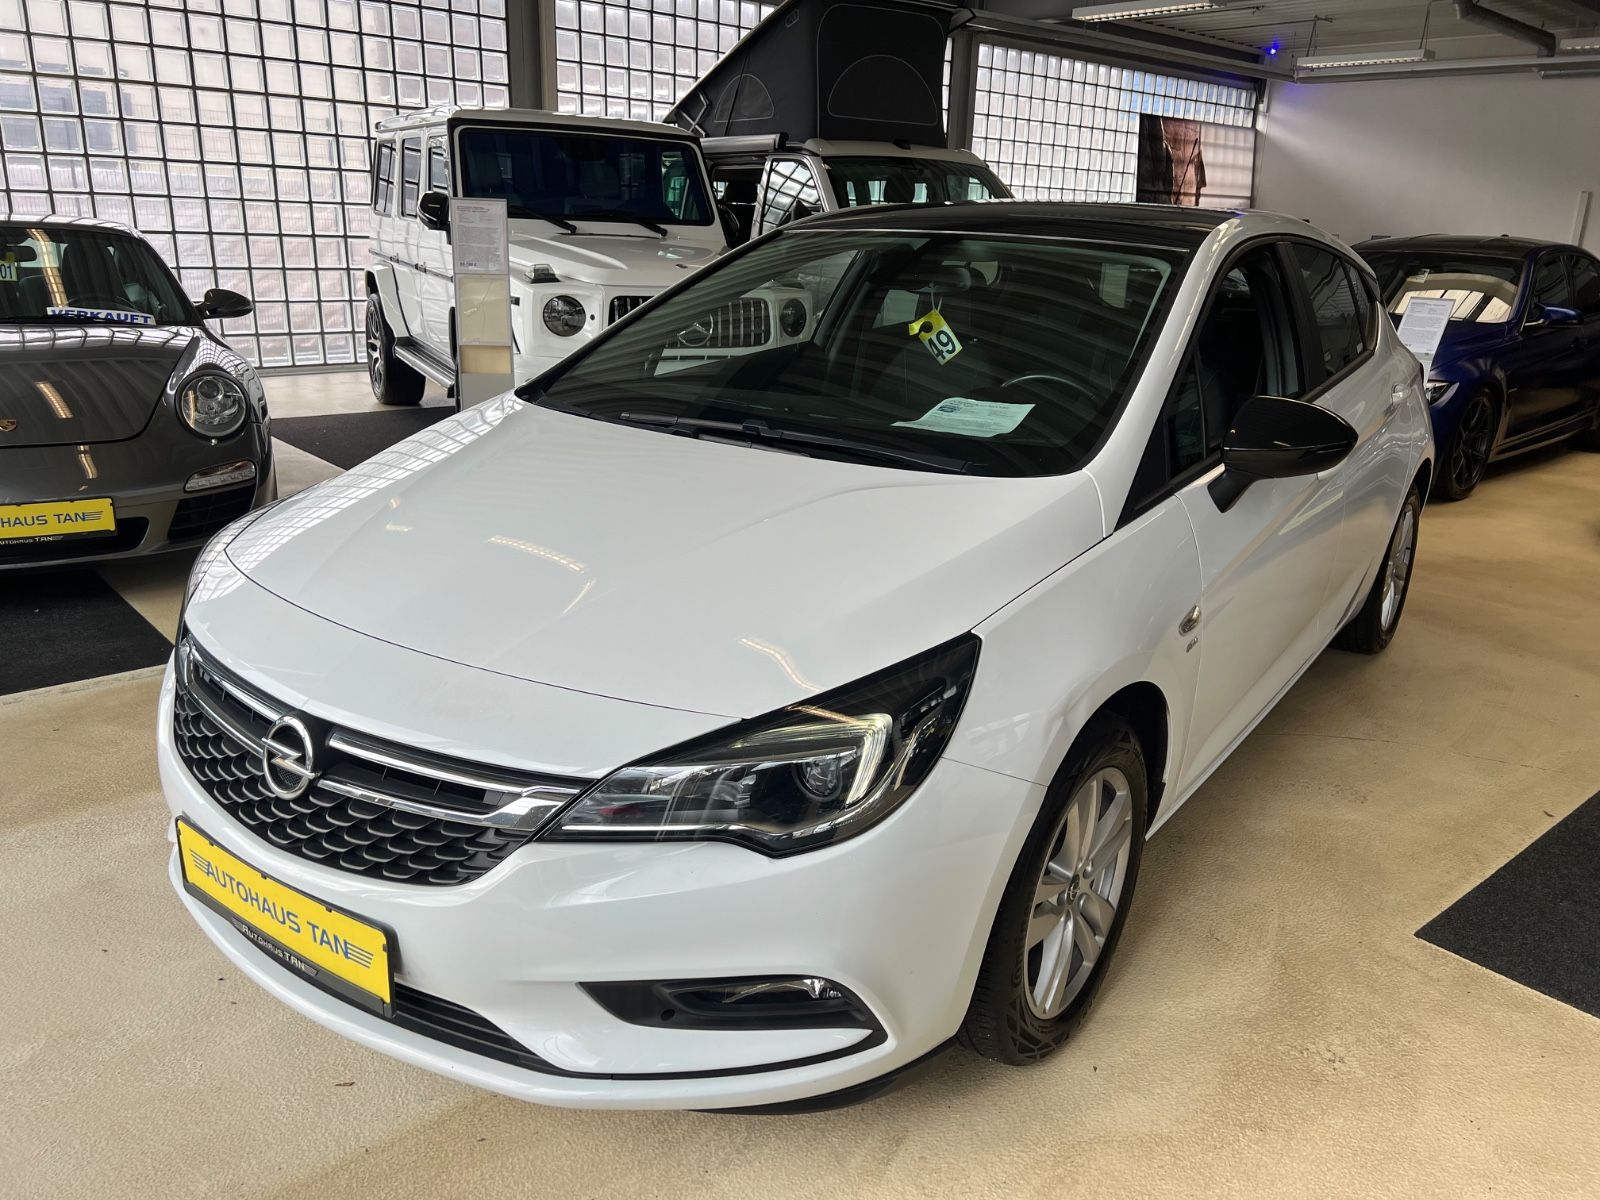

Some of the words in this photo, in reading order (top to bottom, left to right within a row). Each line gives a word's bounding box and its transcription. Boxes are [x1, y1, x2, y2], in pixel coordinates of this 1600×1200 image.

[51, 309, 152, 324] VERKAUFT
[928, 330, 956, 360] 49
[53, 512, 85, 524] TAN
[206, 861, 301, 934] AUTOHAUS
[307, 921, 350, 960] TAN
[284, 951, 305, 971] TAN
